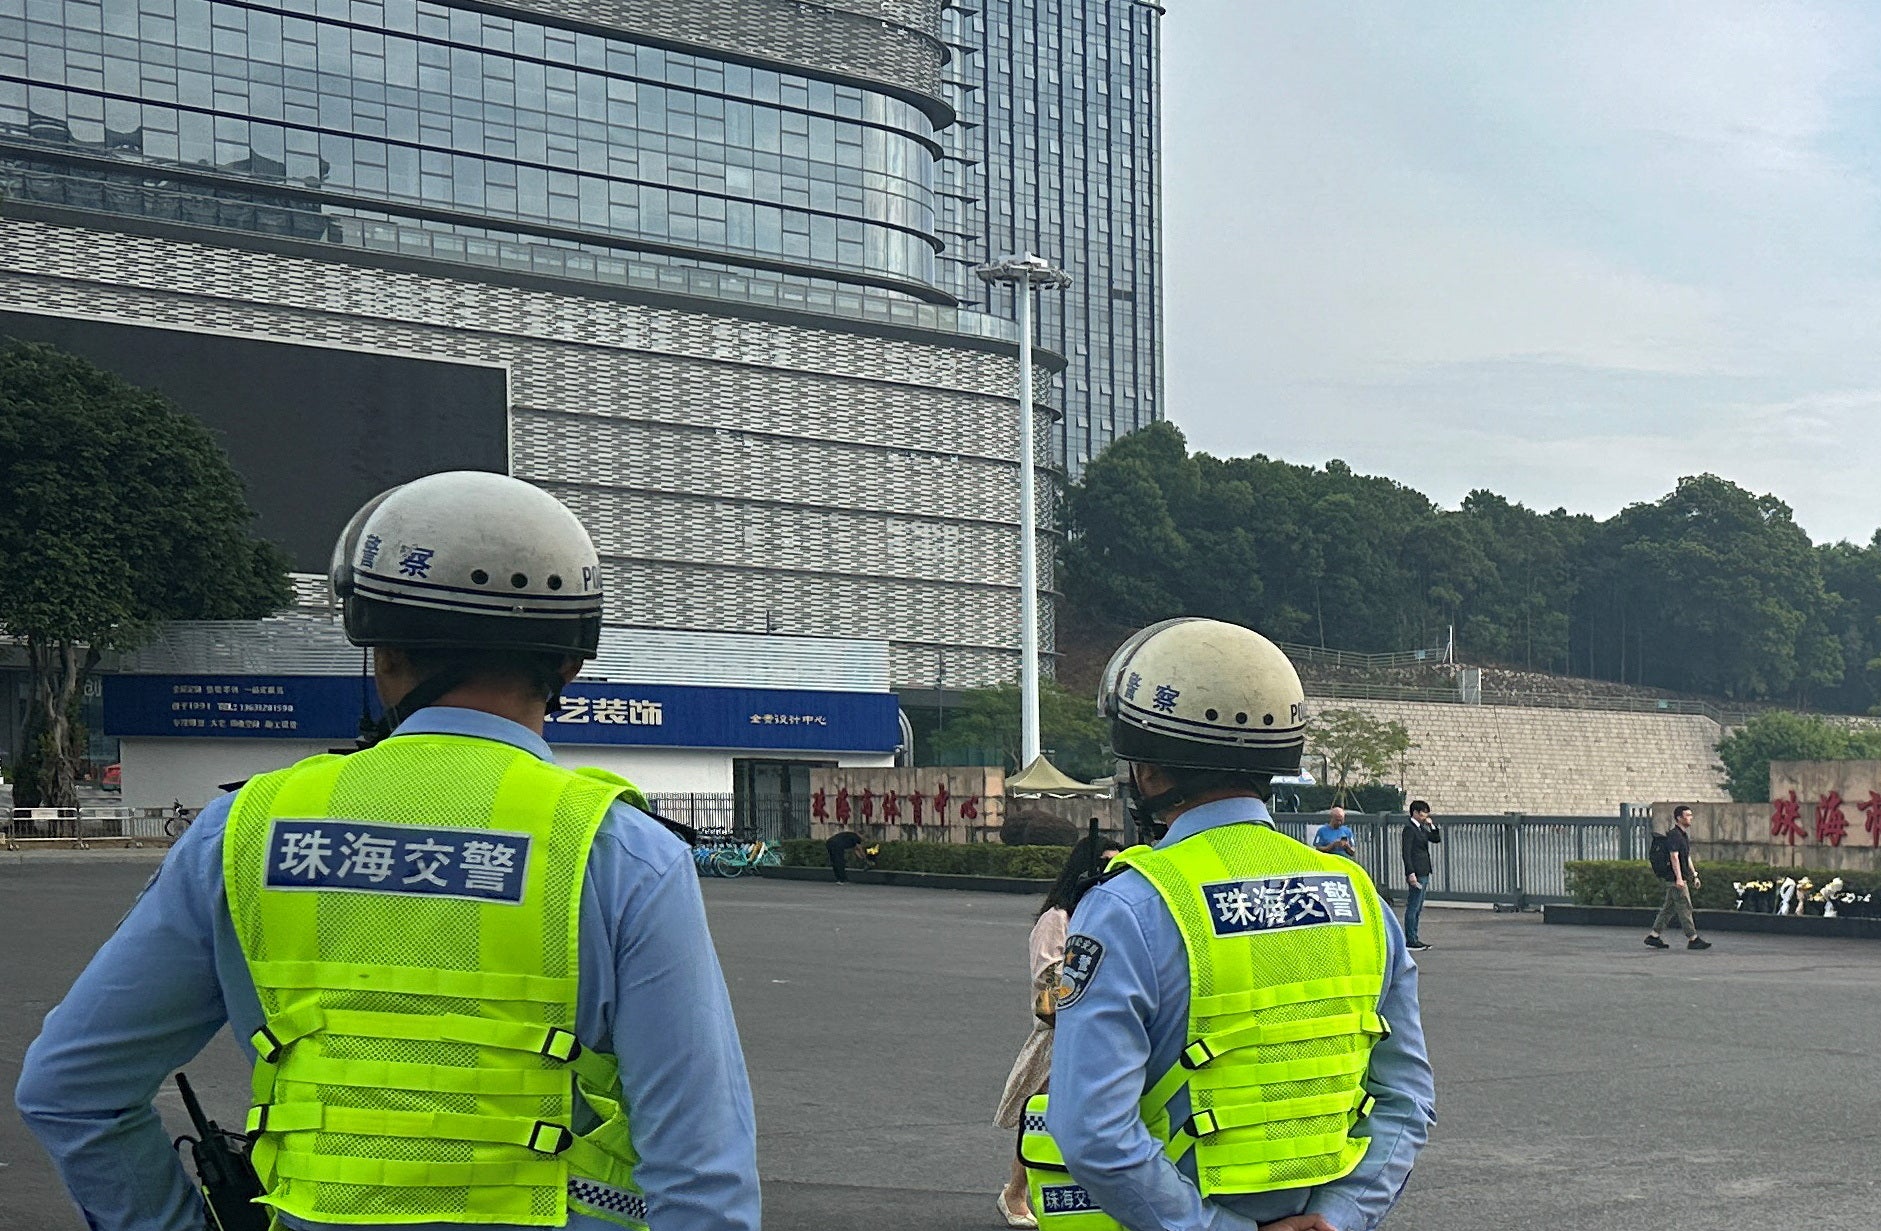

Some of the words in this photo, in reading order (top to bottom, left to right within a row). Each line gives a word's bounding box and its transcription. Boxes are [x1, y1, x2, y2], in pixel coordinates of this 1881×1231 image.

[360, 533, 435, 579] 警察
[544, 696, 663, 726] 艺装饰
[1124, 671, 1181, 714] 警察
[279, 829, 516, 892] 珠海交警
[1213, 880, 1353, 928] 珠海交警
